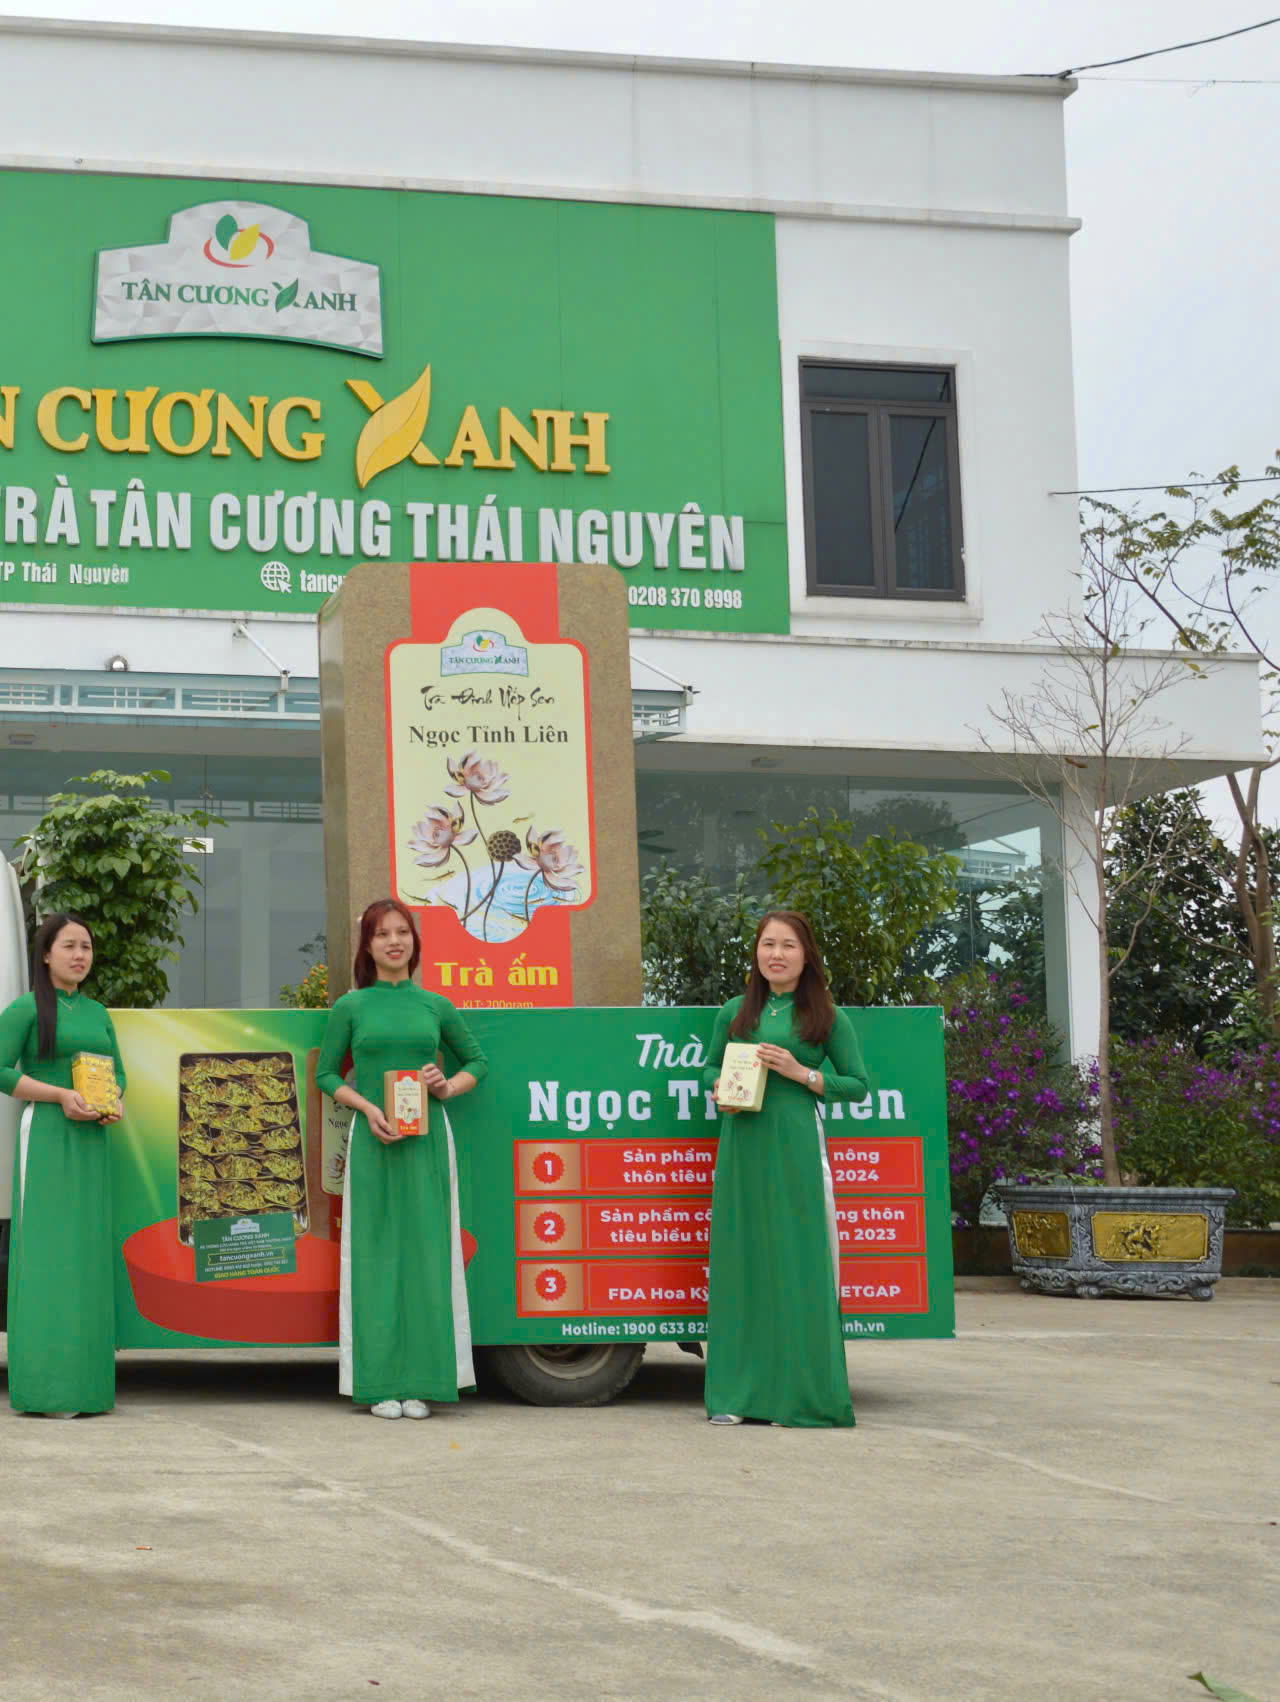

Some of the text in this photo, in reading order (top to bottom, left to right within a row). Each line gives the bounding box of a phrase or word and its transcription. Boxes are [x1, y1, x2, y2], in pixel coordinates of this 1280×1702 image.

[121, 278, 170, 301] TÂN
[177, 284, 269, 307] CƯƠNG
[36, 386, 325, 461] CƯƠNG
[90, 478, 192, 549] TÂN
[209, 490, 392, 557] CƯƠNG
[406, 494, 523, 562] THÁI
[538, 502, 745, 570] NGUYÊN
[22, 562, 57, 583] Thái
[69, 563, 130, 585] Nguyên
[628, 586, 742, 608] 0208 370 8998
[409, 726, 460, 748] Ngọc
[523, 725, 569, 743] Liên
[433, 952, 559, 986] Trà ấm
[635, 1033, 709, 1070] Trà
[528, 1080, 652, 1132] Ngọc
[623, 1148, 712, 1165] Sản phẩm
[833, 1148, 880, 1164] nông
[544, 1160, 553, 1175] 1
[835, 1169, 880, 1181] 2024
[623, 1169, 666, 1183] thôn
[671, 1169, 707, 1183] tiêu
[600, 1208, 633, 1222] Sản
[638, 1208, 690, 1224] phẩm
[862, 1208, 905, 1220] thôn
[543, 1220, 557, 1235] 2
[610, 1230, 647, 1242] tiêu
[651, 1228, 692, 1242] biểu
[854, 1228, 896, 1241] 2023
[545, 1277, 557, 1293] 3
[608, 1288, 646, 1300] FDA
[650, 1288, 686, 1299] Hoa
[561, 1322, 620, 1336] Hotline:
[623, 1322, 656, 1336] 1900
[660, 1321, 685, 1335] 633
[841, 1319, 885, 1333] nh.vn
